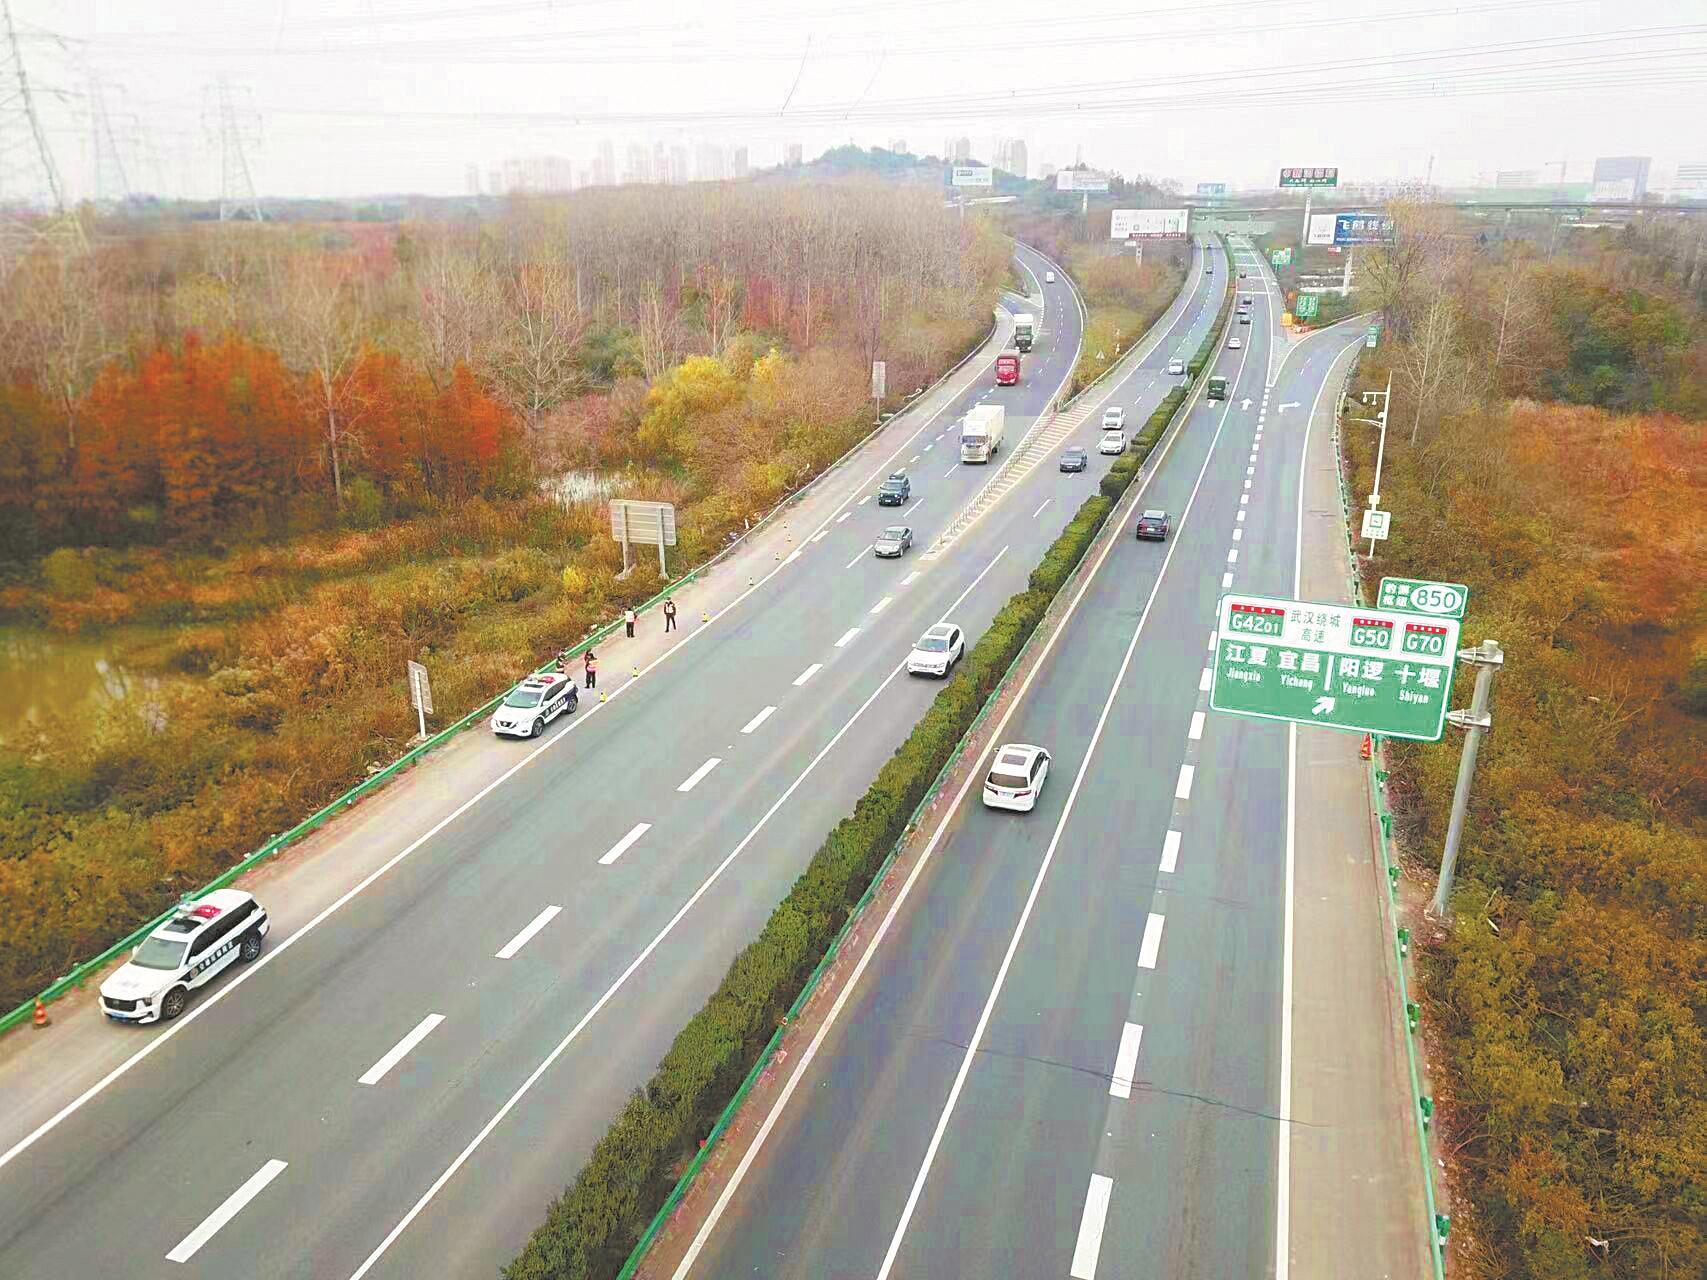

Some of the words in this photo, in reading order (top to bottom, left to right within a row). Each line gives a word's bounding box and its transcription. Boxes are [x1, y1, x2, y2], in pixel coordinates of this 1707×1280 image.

[1416, 589, 1456, 609] 850
[1231, 613, 1280, 634] G4201
[1290, 609, 1341, 628] 武汉绕城
[1301, 628, 1326, 643] 高速
[1353, 627, 1390, 648] G50
[1405, 633, 1443, 653] G70
[1224, 642, 1269, 667] 江夏
[1276, 650, 1321, 673] 宜昌
[1338, 657, 1385, 681] 阳逻
[1393, 664, 1441, 688] 十堰
